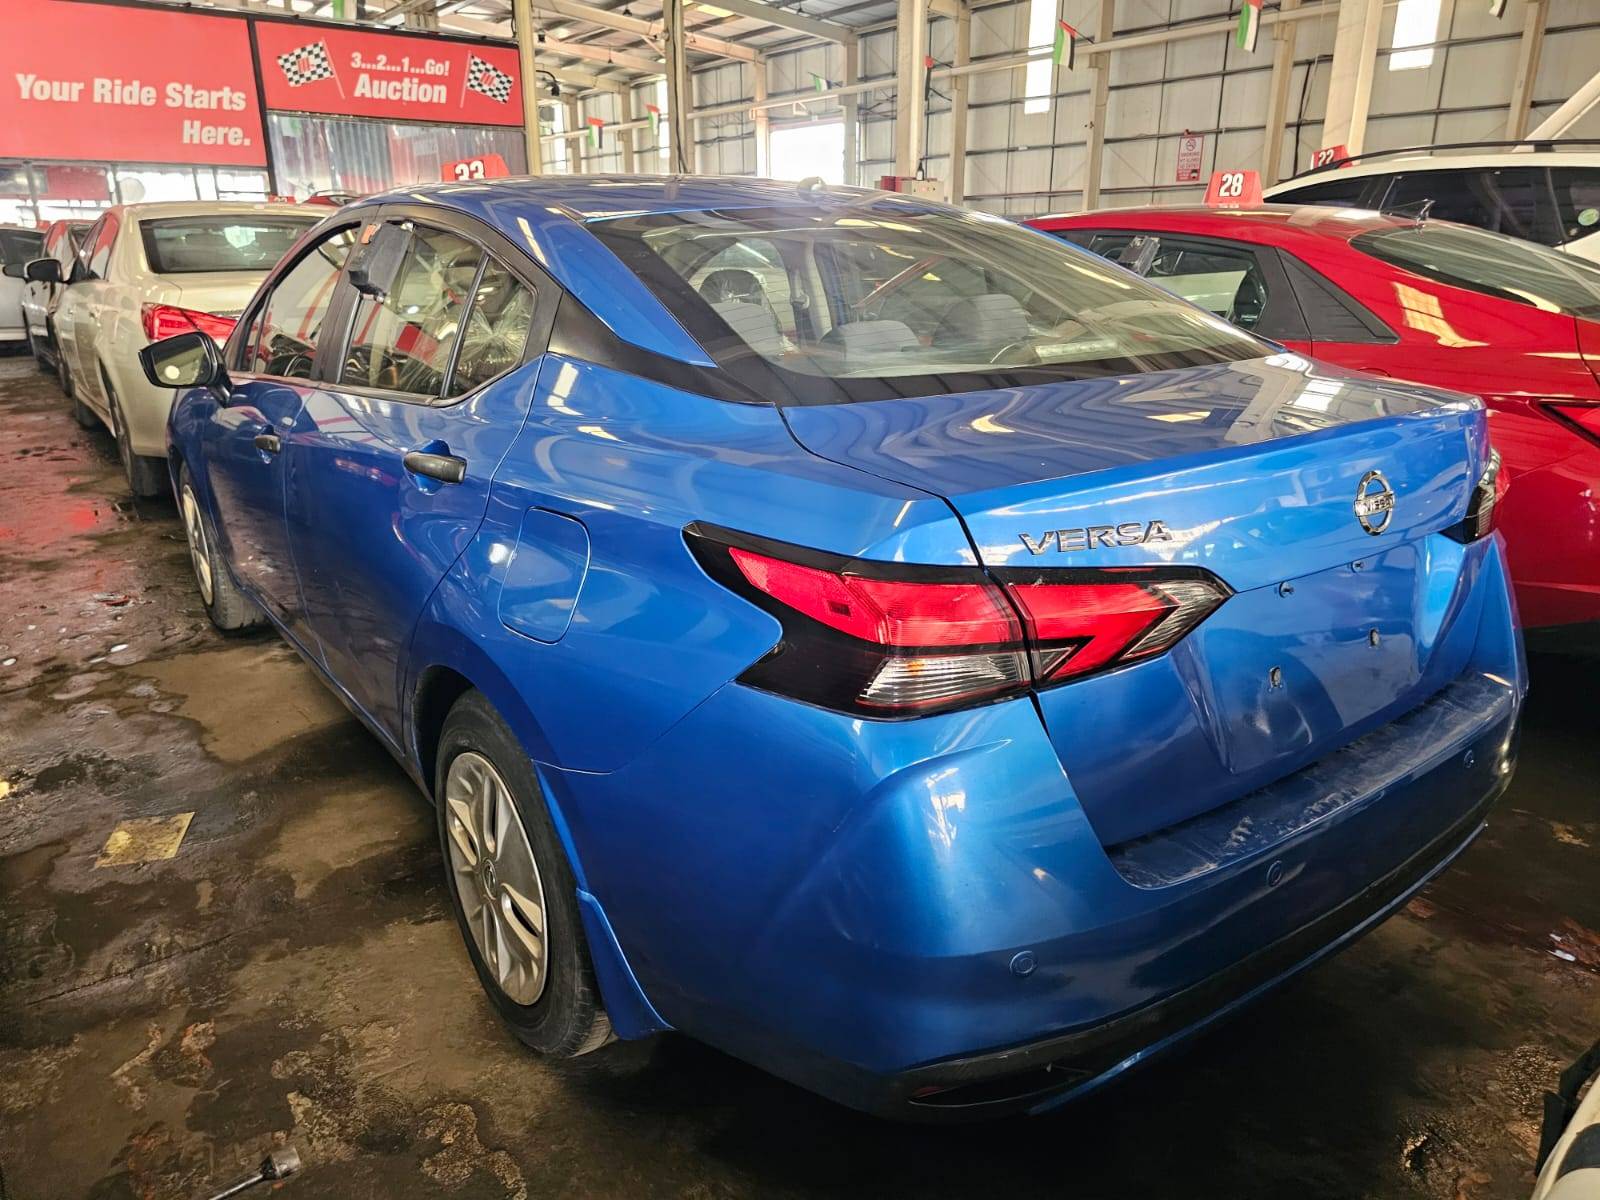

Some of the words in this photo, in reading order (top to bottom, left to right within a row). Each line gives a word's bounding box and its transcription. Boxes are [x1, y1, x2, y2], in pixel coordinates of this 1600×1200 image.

[16, 73, 84, 103] Your
[93, 77, 157, 106] Ride
[165, 82, 247, 111] Starts
[354, 73, 448, 104] Auction
[182, 120, 251, 146] Here.
[1219, 173, 1244, 197] 28
[1018, 520, 1173, 555] VERSA
